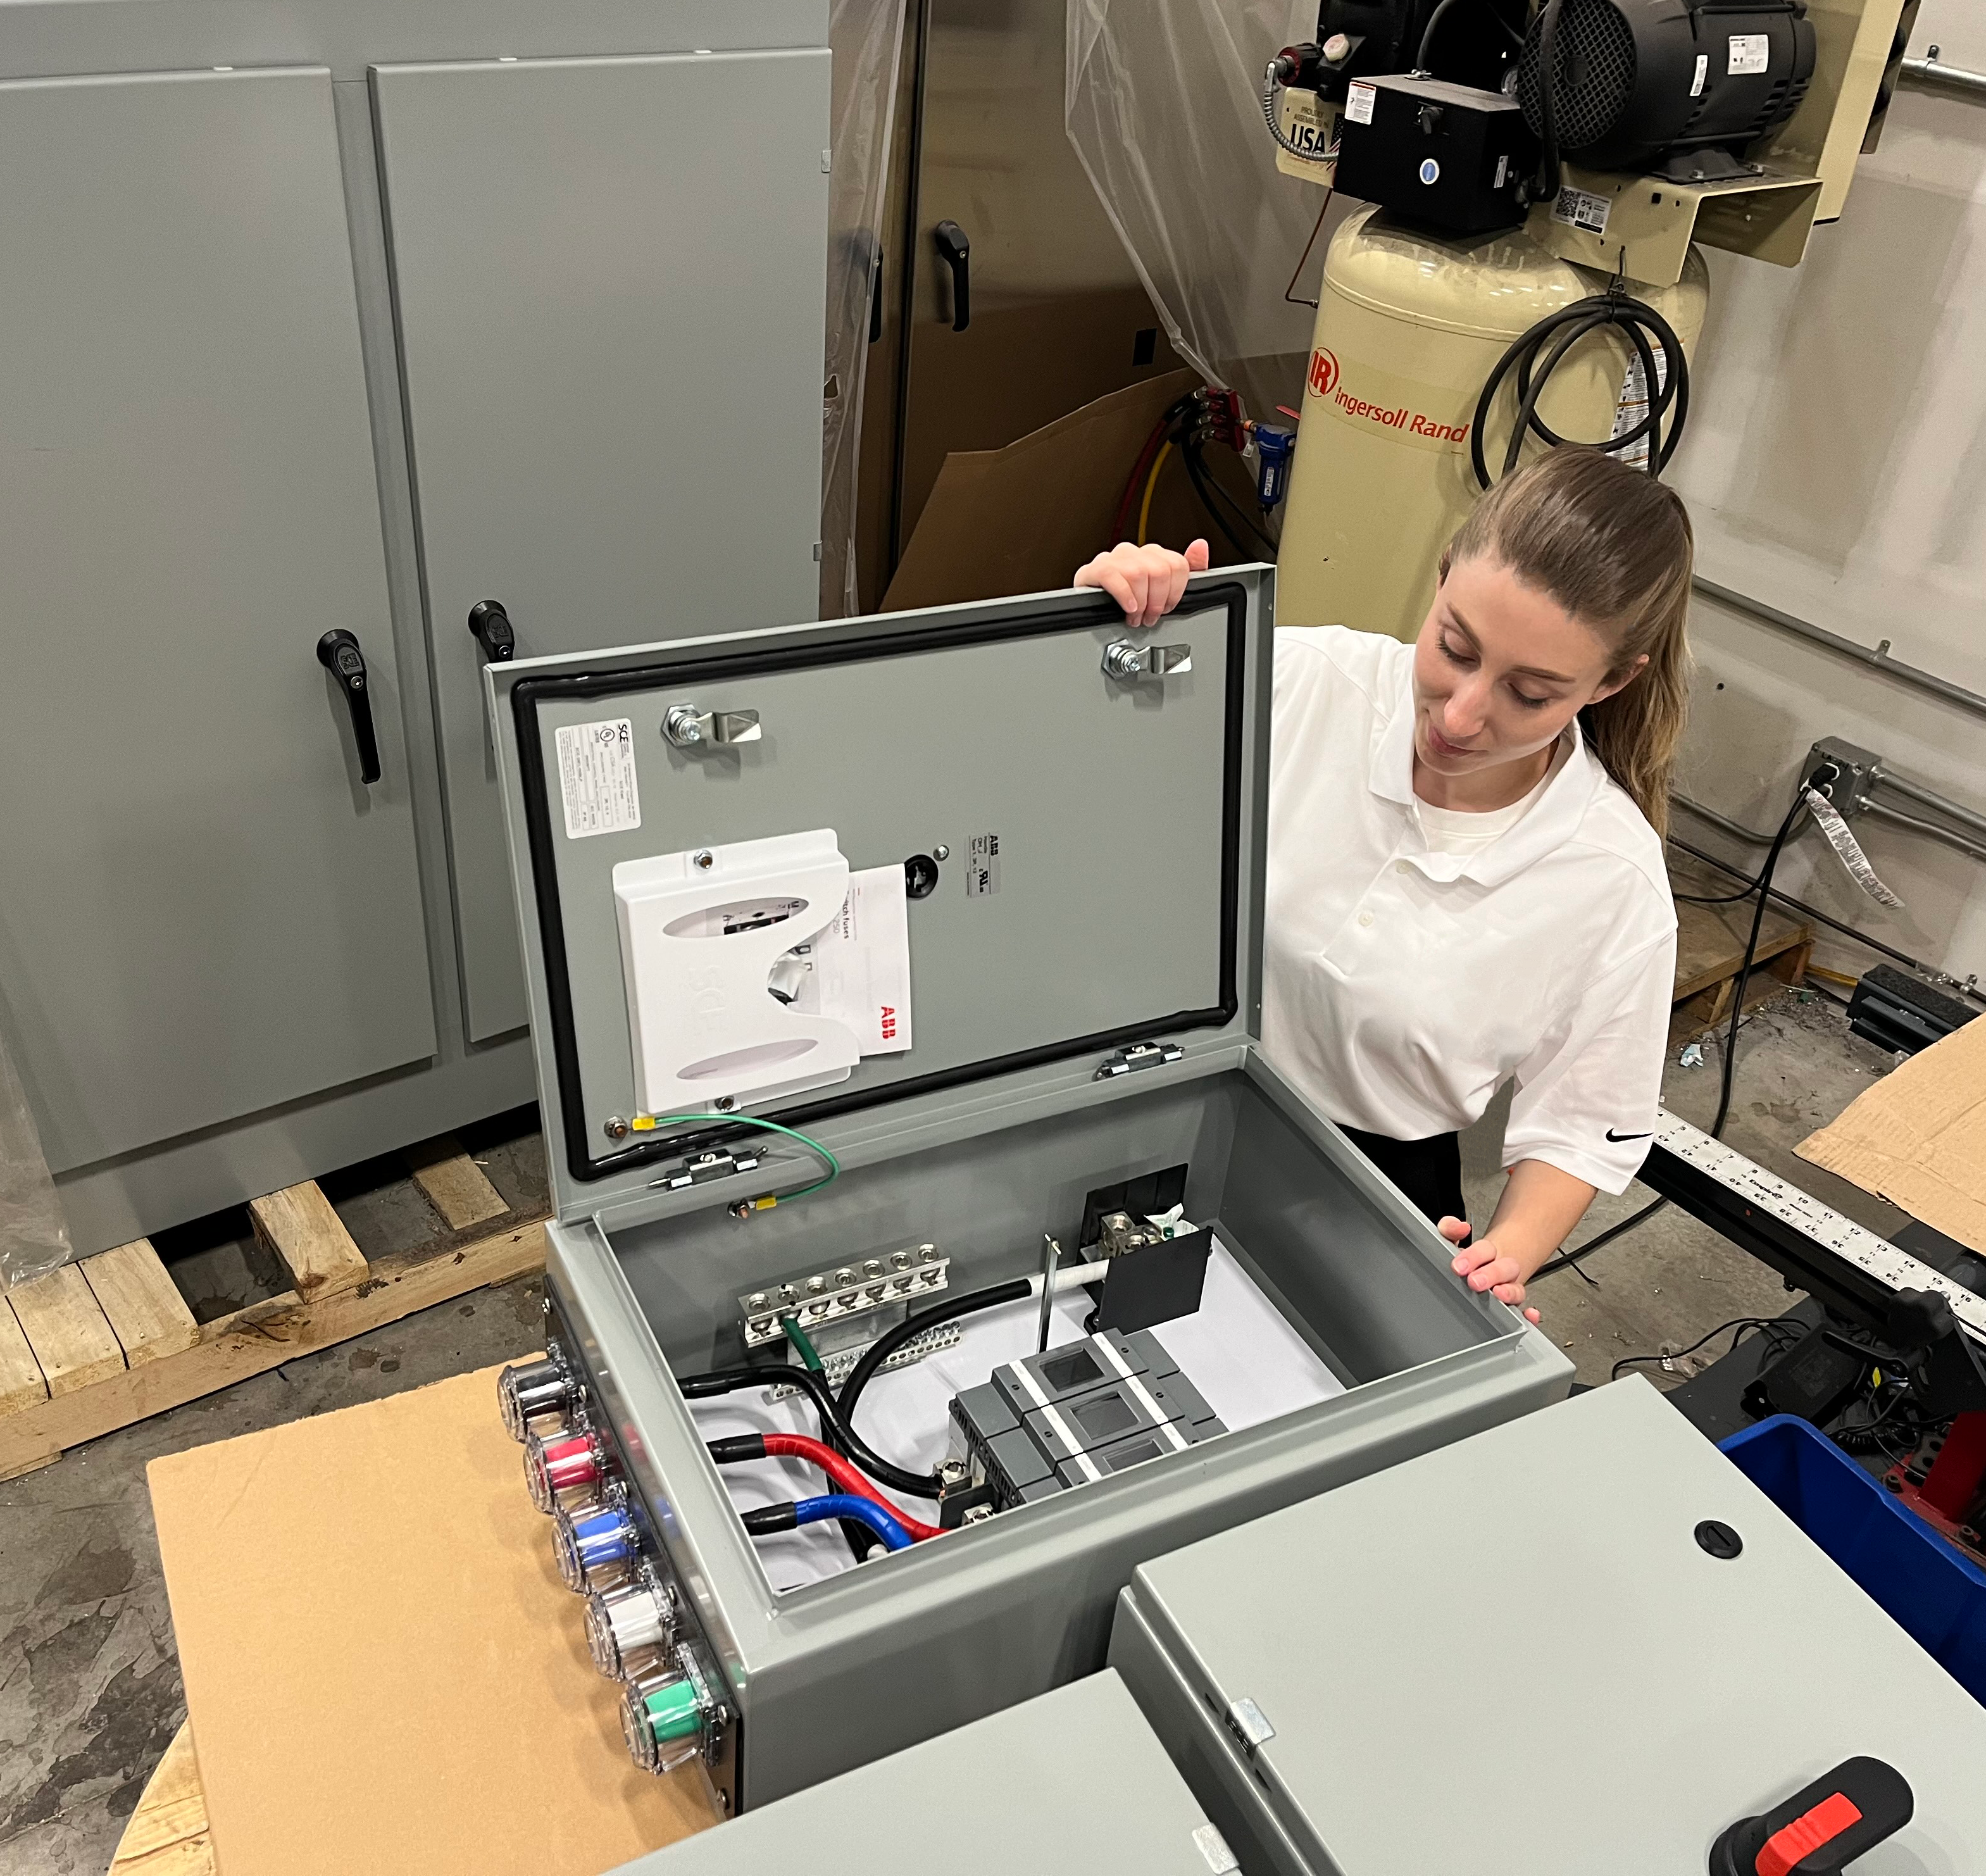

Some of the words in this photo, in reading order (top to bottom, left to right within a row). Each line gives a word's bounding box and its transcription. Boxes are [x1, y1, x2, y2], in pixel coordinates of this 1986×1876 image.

[1290, 123, 1325, 153] USA
[1335, 386, 1409, 429] Ingersoll
[1409, 415, 1470, 443] Rand
[618, 724, 628, 742] SCE
[990, 835, 999, 856] ABB
[881, 1006, 896, 1039] ABB
[1886, 1273, 1899, 1282] 34
[1961, 1294, 1971, 1302] 16
